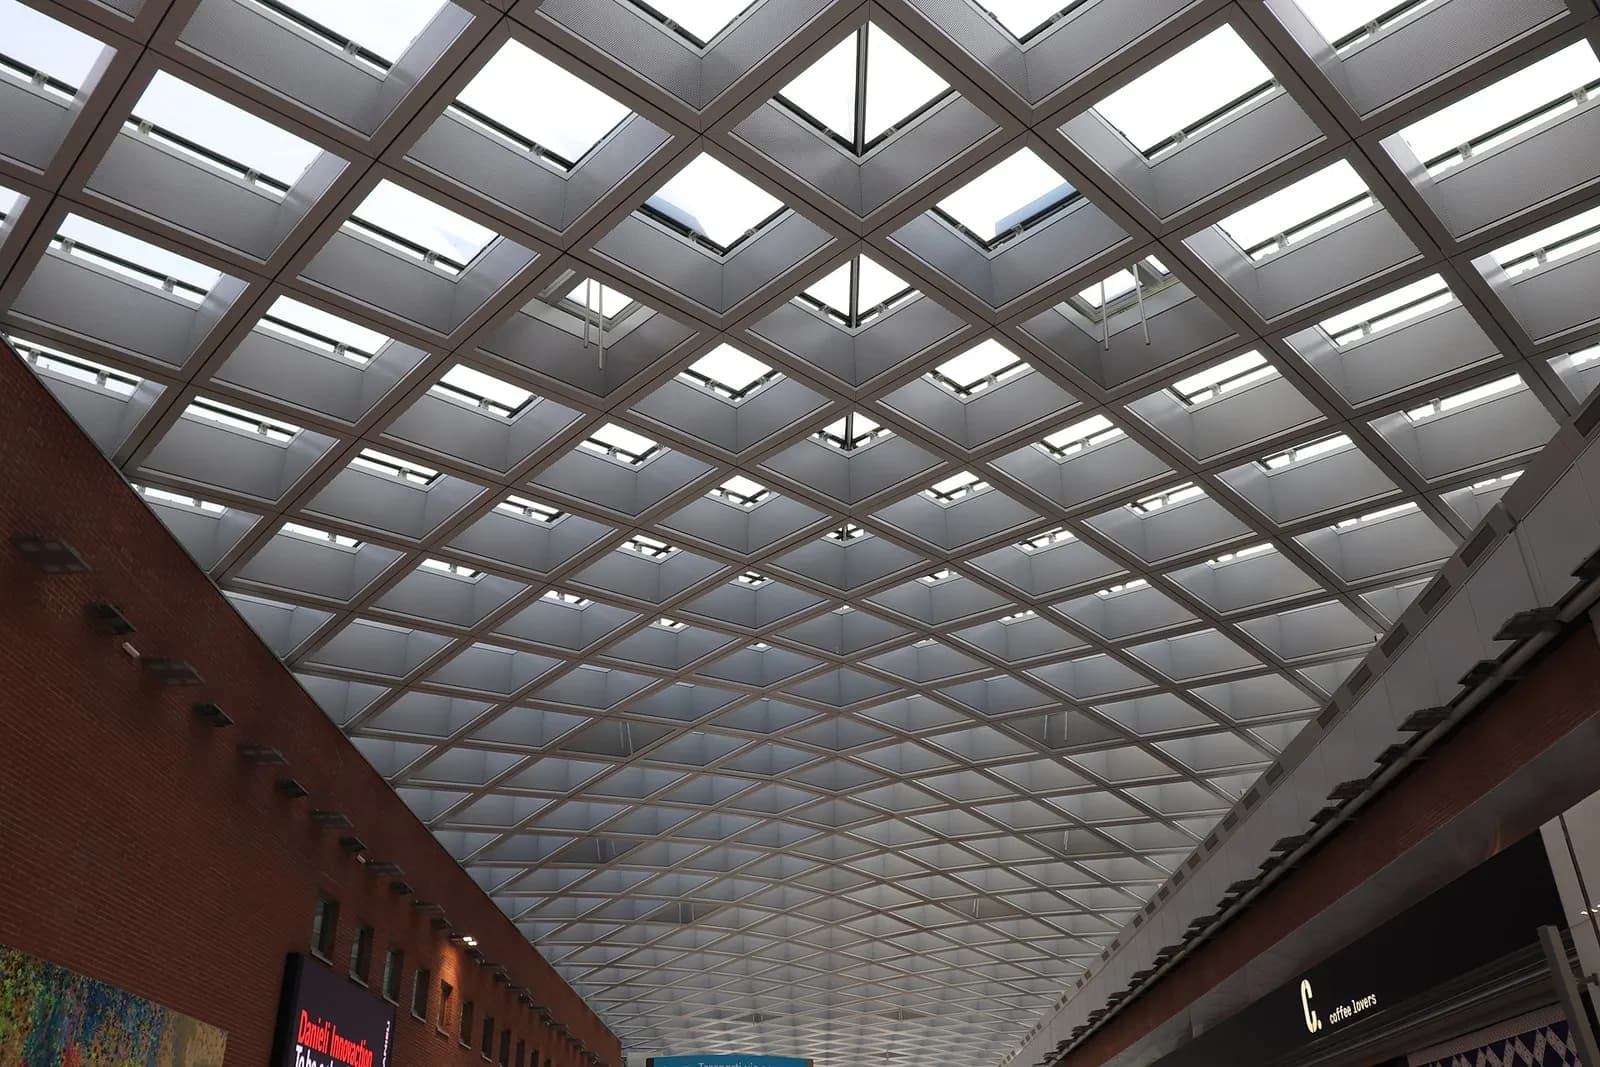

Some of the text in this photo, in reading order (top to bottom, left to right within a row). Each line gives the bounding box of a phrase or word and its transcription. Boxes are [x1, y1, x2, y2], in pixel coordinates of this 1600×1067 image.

[1300, 979, 1377, 1033] C. coffee lovers
[297, 1008, 331, 1054] Danieli
[330, 1025, 373, 1067] Innovaction
